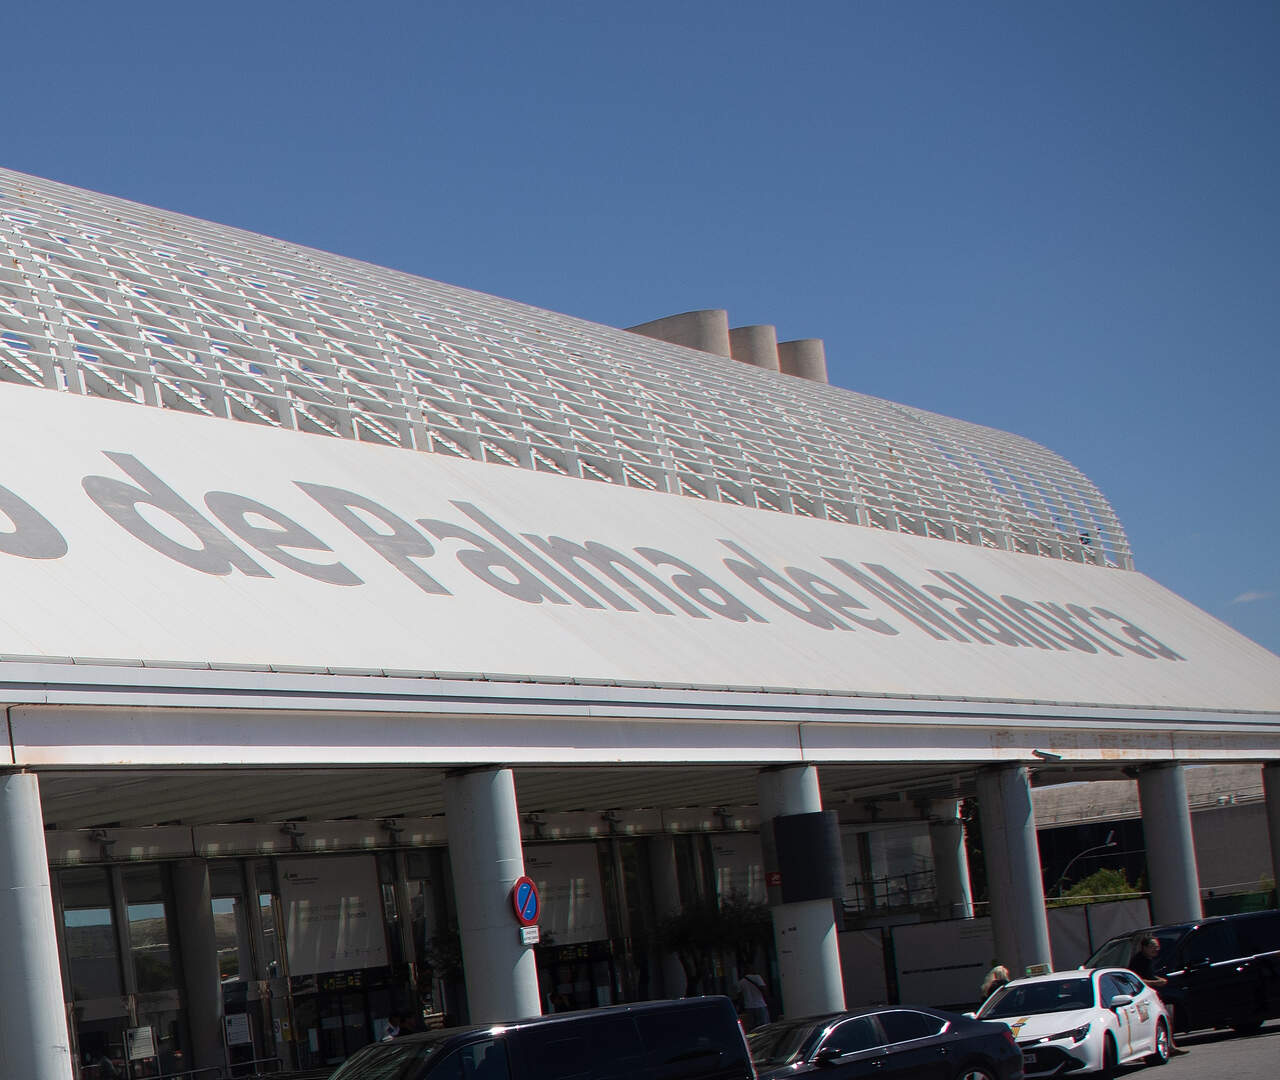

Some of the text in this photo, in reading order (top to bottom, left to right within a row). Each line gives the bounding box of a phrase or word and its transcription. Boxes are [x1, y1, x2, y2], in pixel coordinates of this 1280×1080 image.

[81, 450, 366, 587] de
[291, 480, 771, 624] Palma
[715, 538, 901, 636] de
[821, 556, 1188, 661] Mallorca
